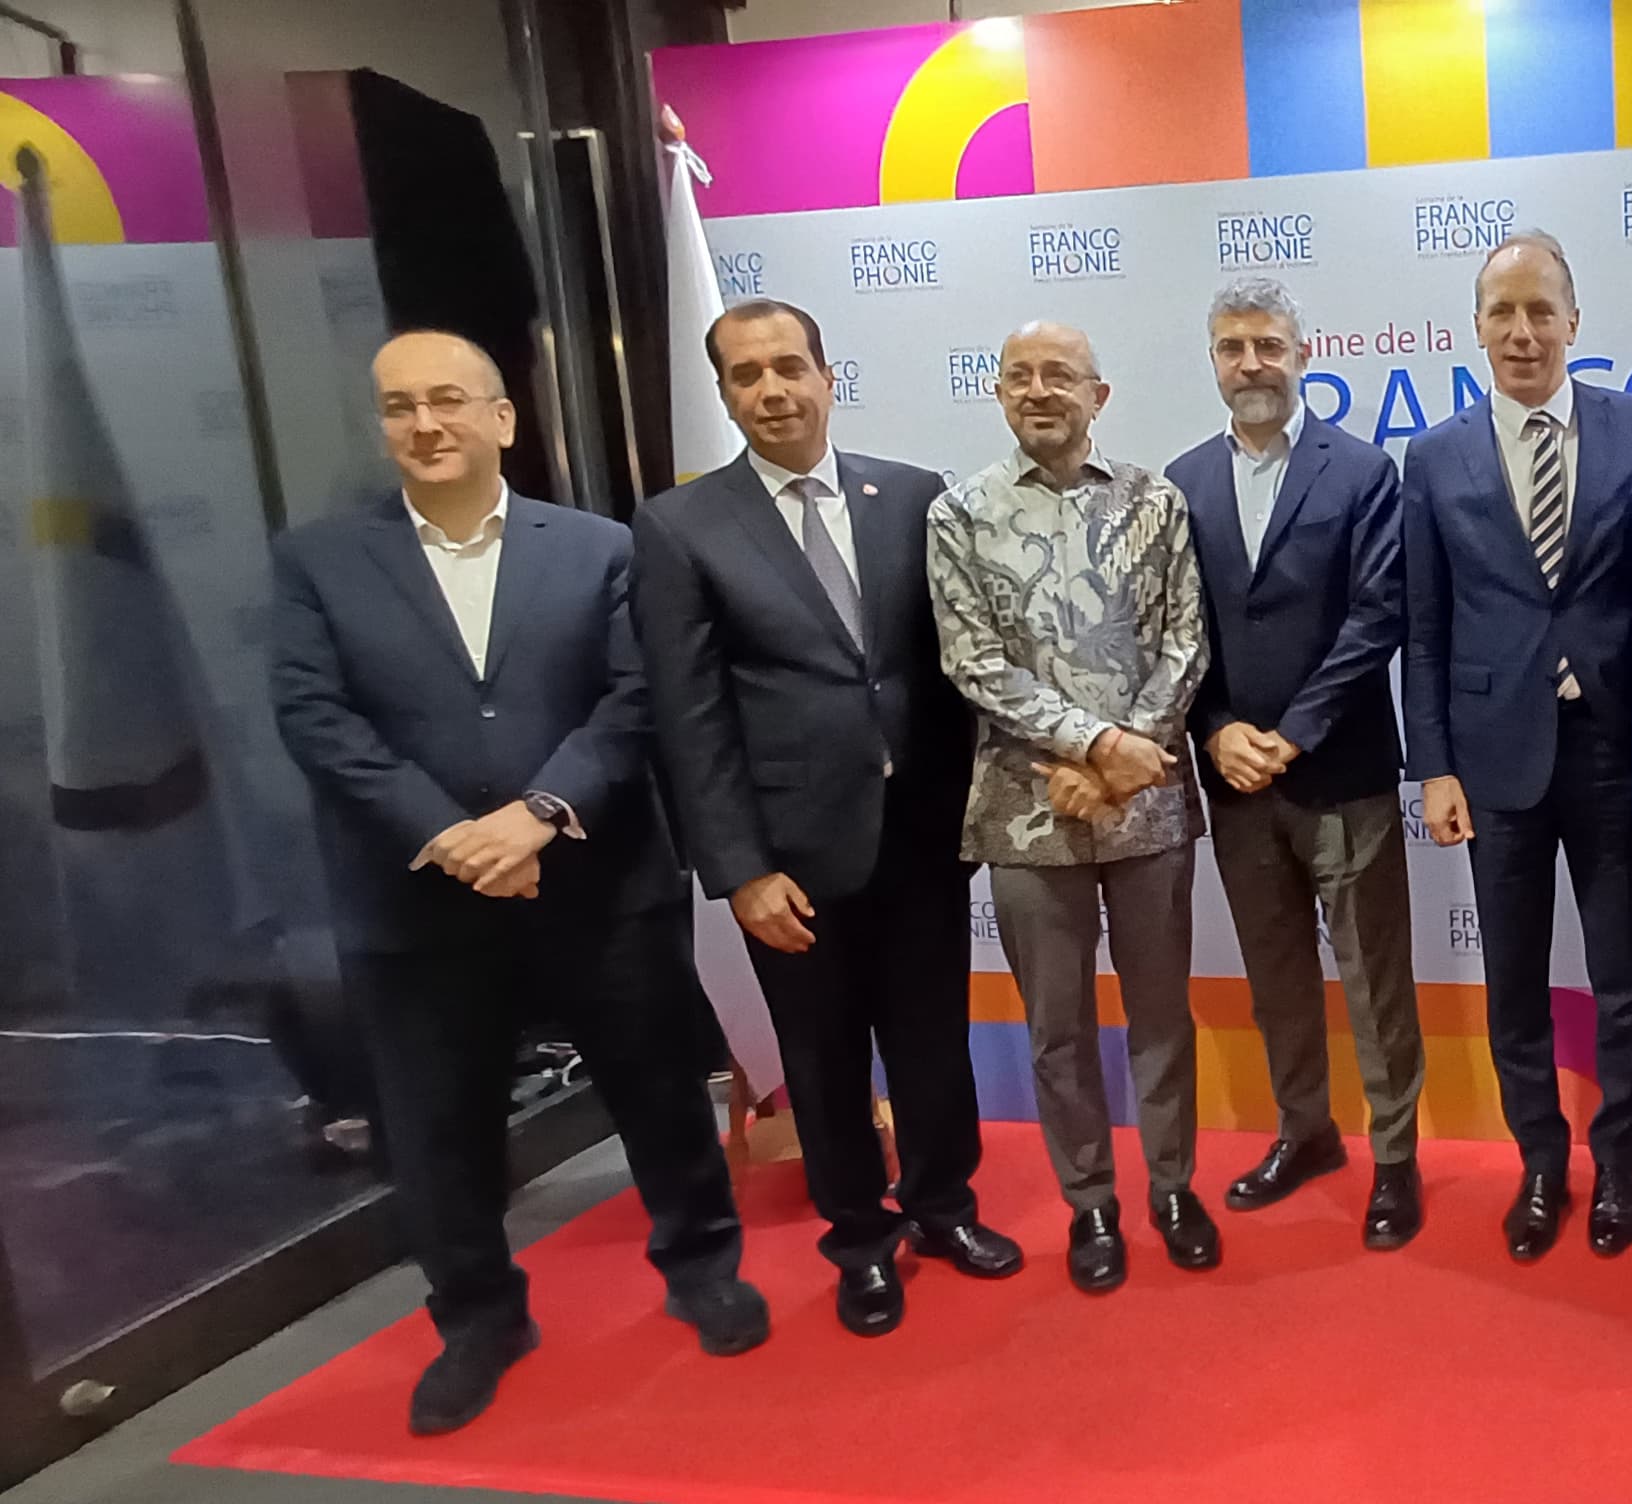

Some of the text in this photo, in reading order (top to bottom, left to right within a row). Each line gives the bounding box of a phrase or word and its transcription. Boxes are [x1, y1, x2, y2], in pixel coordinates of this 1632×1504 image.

[1031, 250, 1121, 276] PHONIE
[1219, 237, 1313, 264] PHONIE
[852, 263, 938, 287] PHONIE
[1375, 322, 1415, 355] de
[1426, 320, 1453, 352] la
[949, 353, 1000, 375] FRAN
[951, 375, 999, 397] PHO
